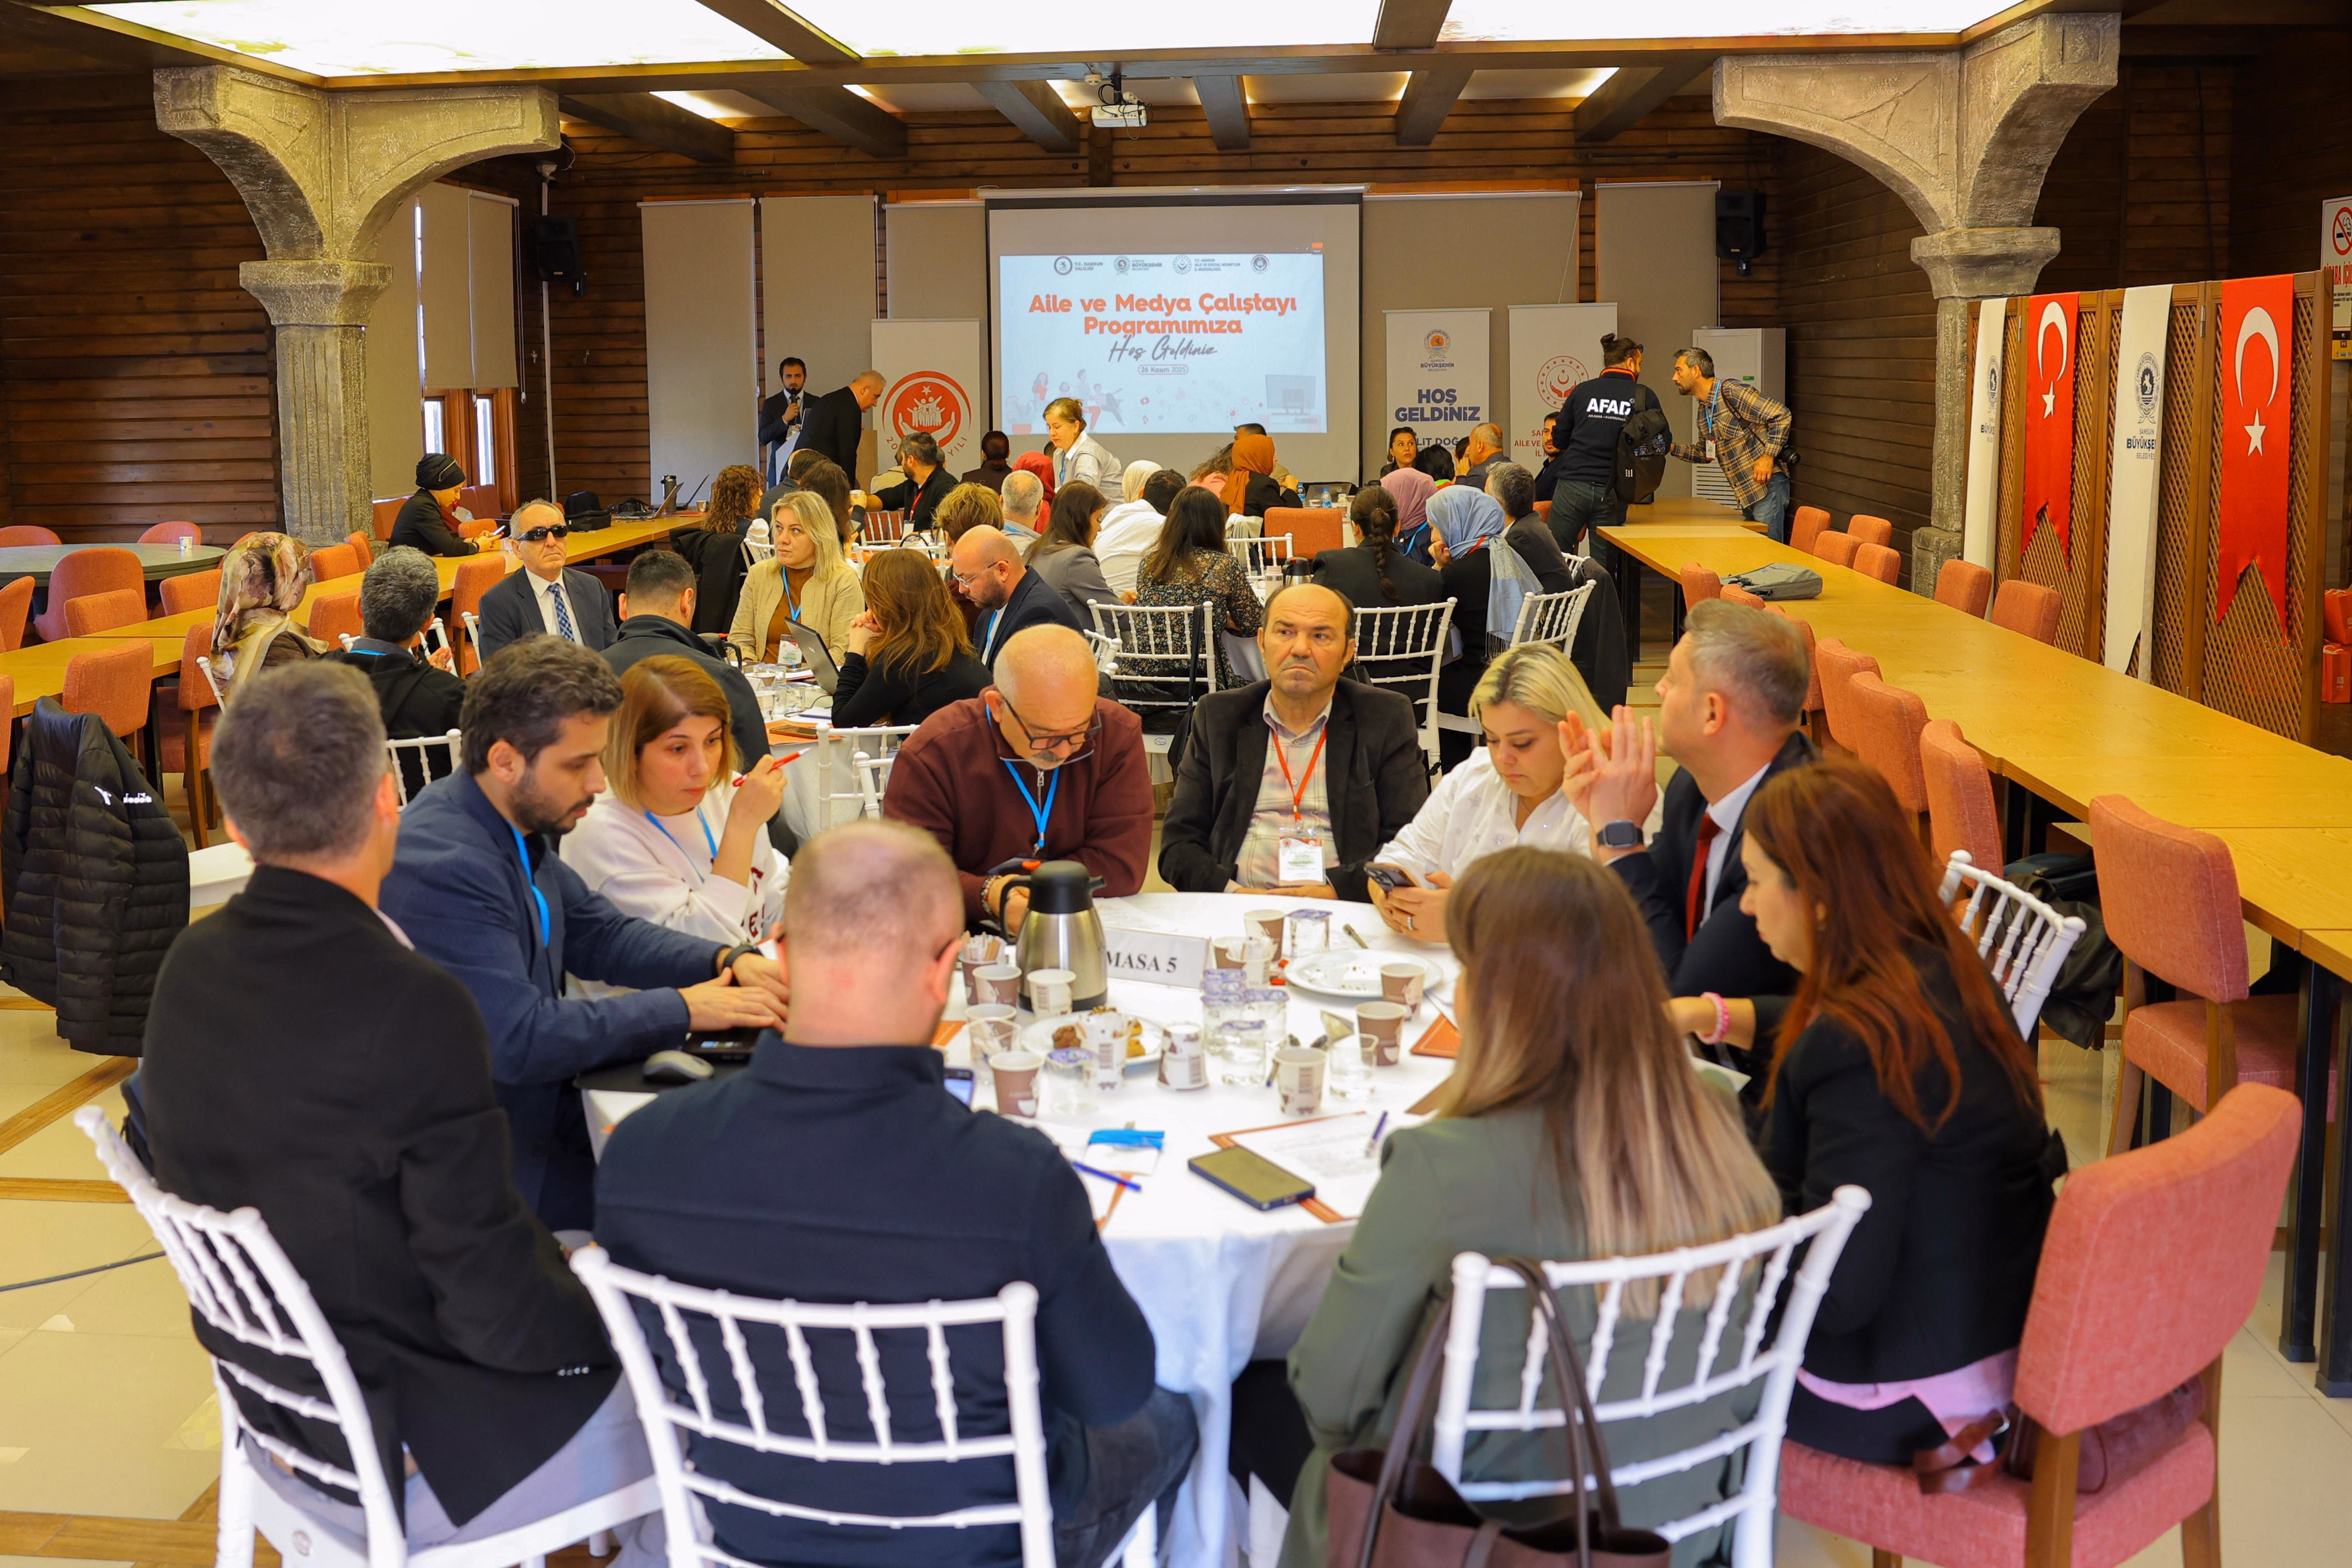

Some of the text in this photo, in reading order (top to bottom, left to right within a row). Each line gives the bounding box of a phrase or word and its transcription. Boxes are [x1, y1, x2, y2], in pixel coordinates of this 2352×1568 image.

[1029, 293, 1297, 317] Aile ve Medya Çalıştayı
[1085, 316, 1243, 338] Programımıza
[1108, 334, 1217, 362] Hoş Geldiniz
[1418, 389, 1457, 406] HOŞ
[1586, 398, 1631, 415] AFAD
[1395, 407, 1480, 422] GELDİNİZ
[947, 437, 967, 457] YILI
[1416, 436, 1459, 446] LİT DOĞ
[1107, 951, 1177, 973] MASA 5
